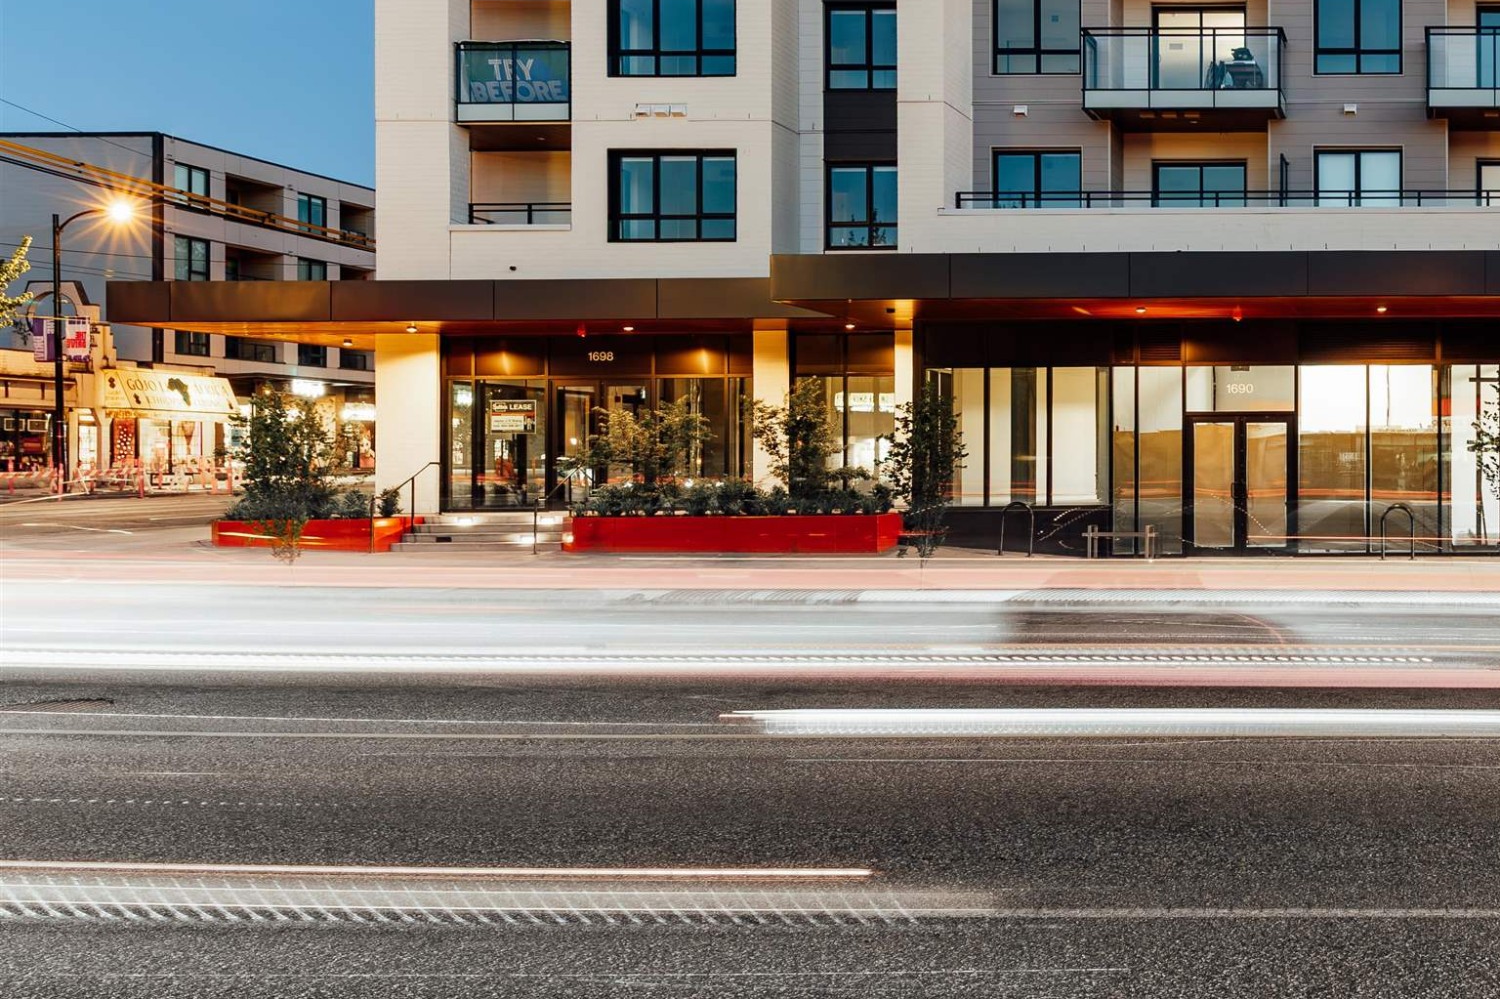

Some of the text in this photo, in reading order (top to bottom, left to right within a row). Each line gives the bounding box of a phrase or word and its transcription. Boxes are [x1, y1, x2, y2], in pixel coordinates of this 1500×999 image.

[488, 58, 534, 81] TRY
[470, 80, 567, 102] BEFORE
[588, 351, 614, 361] 1698
[1226, 383, 1254, 394] 1690
